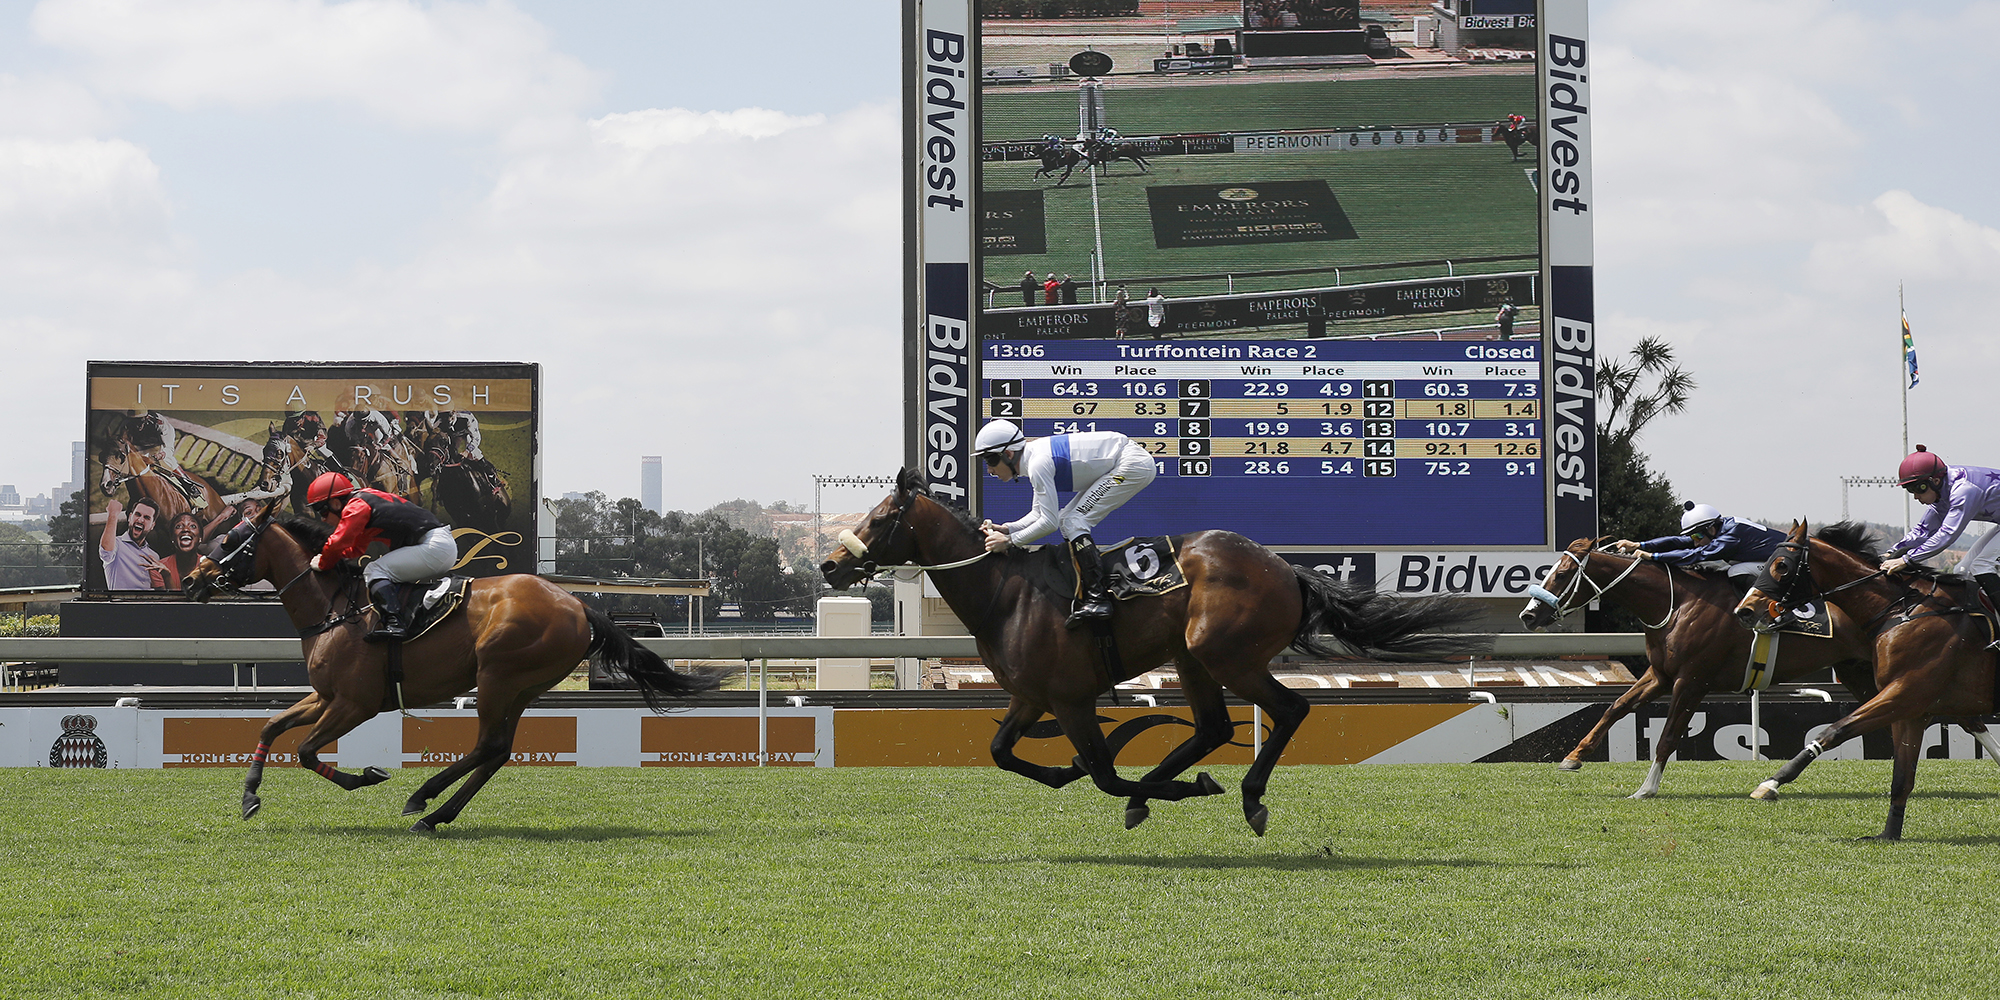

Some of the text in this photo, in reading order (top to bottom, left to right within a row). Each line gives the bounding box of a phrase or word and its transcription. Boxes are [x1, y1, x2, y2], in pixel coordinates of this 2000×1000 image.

[1465, 17, 1509, 28] Bidvest
[927, 28, 965, 212] Bidvest
[1549, 33, 1588, 216] Bidvest
[1246, 135, 1332, 149] PEERMONT
[1177, 200, 1310, 213] EMPERORS
[1396, 286, 1462, 301] EMPERORS
[1248, 296, 1318, 313] EMPERORS
[1412, 299, 1445, 309] PALACE
[1018, 313, 1089, 328] EMPERORS
[1266, 310, 1300, 320] PALACE
[1036, 326, 1071, 336] PALACE
[989, 344, 1045, 358] 13:06
[1117, 344, 1318, 359] Turffontein Race 2
[1465, 345, 1535, 359] Closed
[1051, 365, 1528, 377] Win Place Win Place Win Place
[138, 384, 490, 406] IT'S A RUSH
[1000, 382, 1537, 397] 1 64.3 10.6 6 22.9 4.9 11 60.3 7.3
[928, 314, 967, 501] Bidvest
[1000, 402, 1534, 416] 2 67 8.3 7 5 1.9 12 1.8 1.4
[1555, 316, 1594, 502] Bidvest
[1053, 421, 1536, 437] 54.1 8 8 19.9 3.6 13 10.7 3.1
[1188, 441, 1201, 455] 9
[1244, 441, 1290, 455] 21.8
[1320, 441, 1353, 455] 4.7
[1366, 442, 1393, 457] 14
[1425, 442, 1468, 456] 92.1
[1494, 442, 1538, 456] 12.6
[1182, 461, 1208, 475] 10
[1244, 461, 1290, 475] 28.6
[1321, 461, 1354, 475] 5.4
[1366, 462, 1393, 476] 15
[1425, 461, 1471, 476] 75.2
[1505, 461, 1537, 476] 9.1
[1396, 555, 1555, 594] Bidves
[181, 752, 231, 763] MONTE
[421, 752, 467, 762] MONT
[530, 752, 557, 762] BAY
[659, 752, 709, 762] MONTE
[770, 752, 797, 762] BAY
